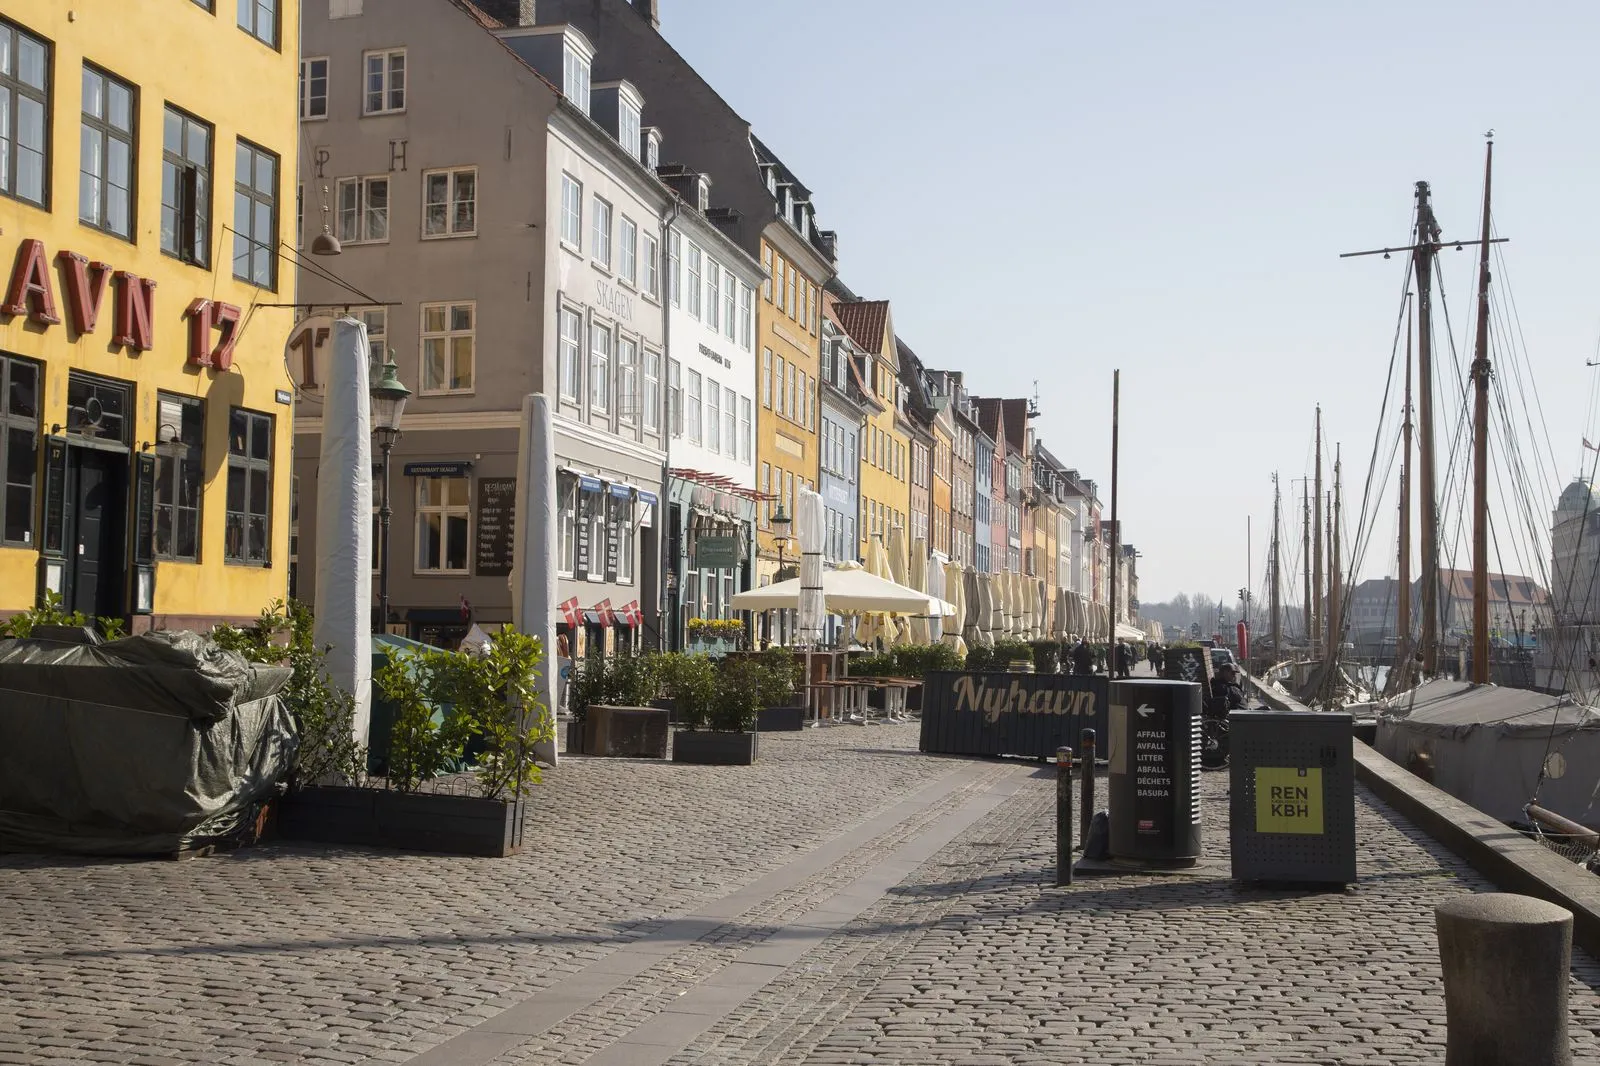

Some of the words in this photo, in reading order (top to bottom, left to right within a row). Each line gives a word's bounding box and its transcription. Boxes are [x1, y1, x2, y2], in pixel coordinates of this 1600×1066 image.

[0, 236, 157, 351] AVN
[185, 297, 241, 372] 17
[596, 279, 634, 322] SKAGEN
[953, 675, 1096, 723] Nyhavn
[1137, 754, 1164, 762] LITTER
[1137, 766, 1166, 774] ABFALL
[1138, 776, 1171, 785] DÉCHETS
[1138, 789, 1169, 797] BASURA
[1271, 786, 1308, 800] REN
[1271, 804, 1309, 818] KBH
